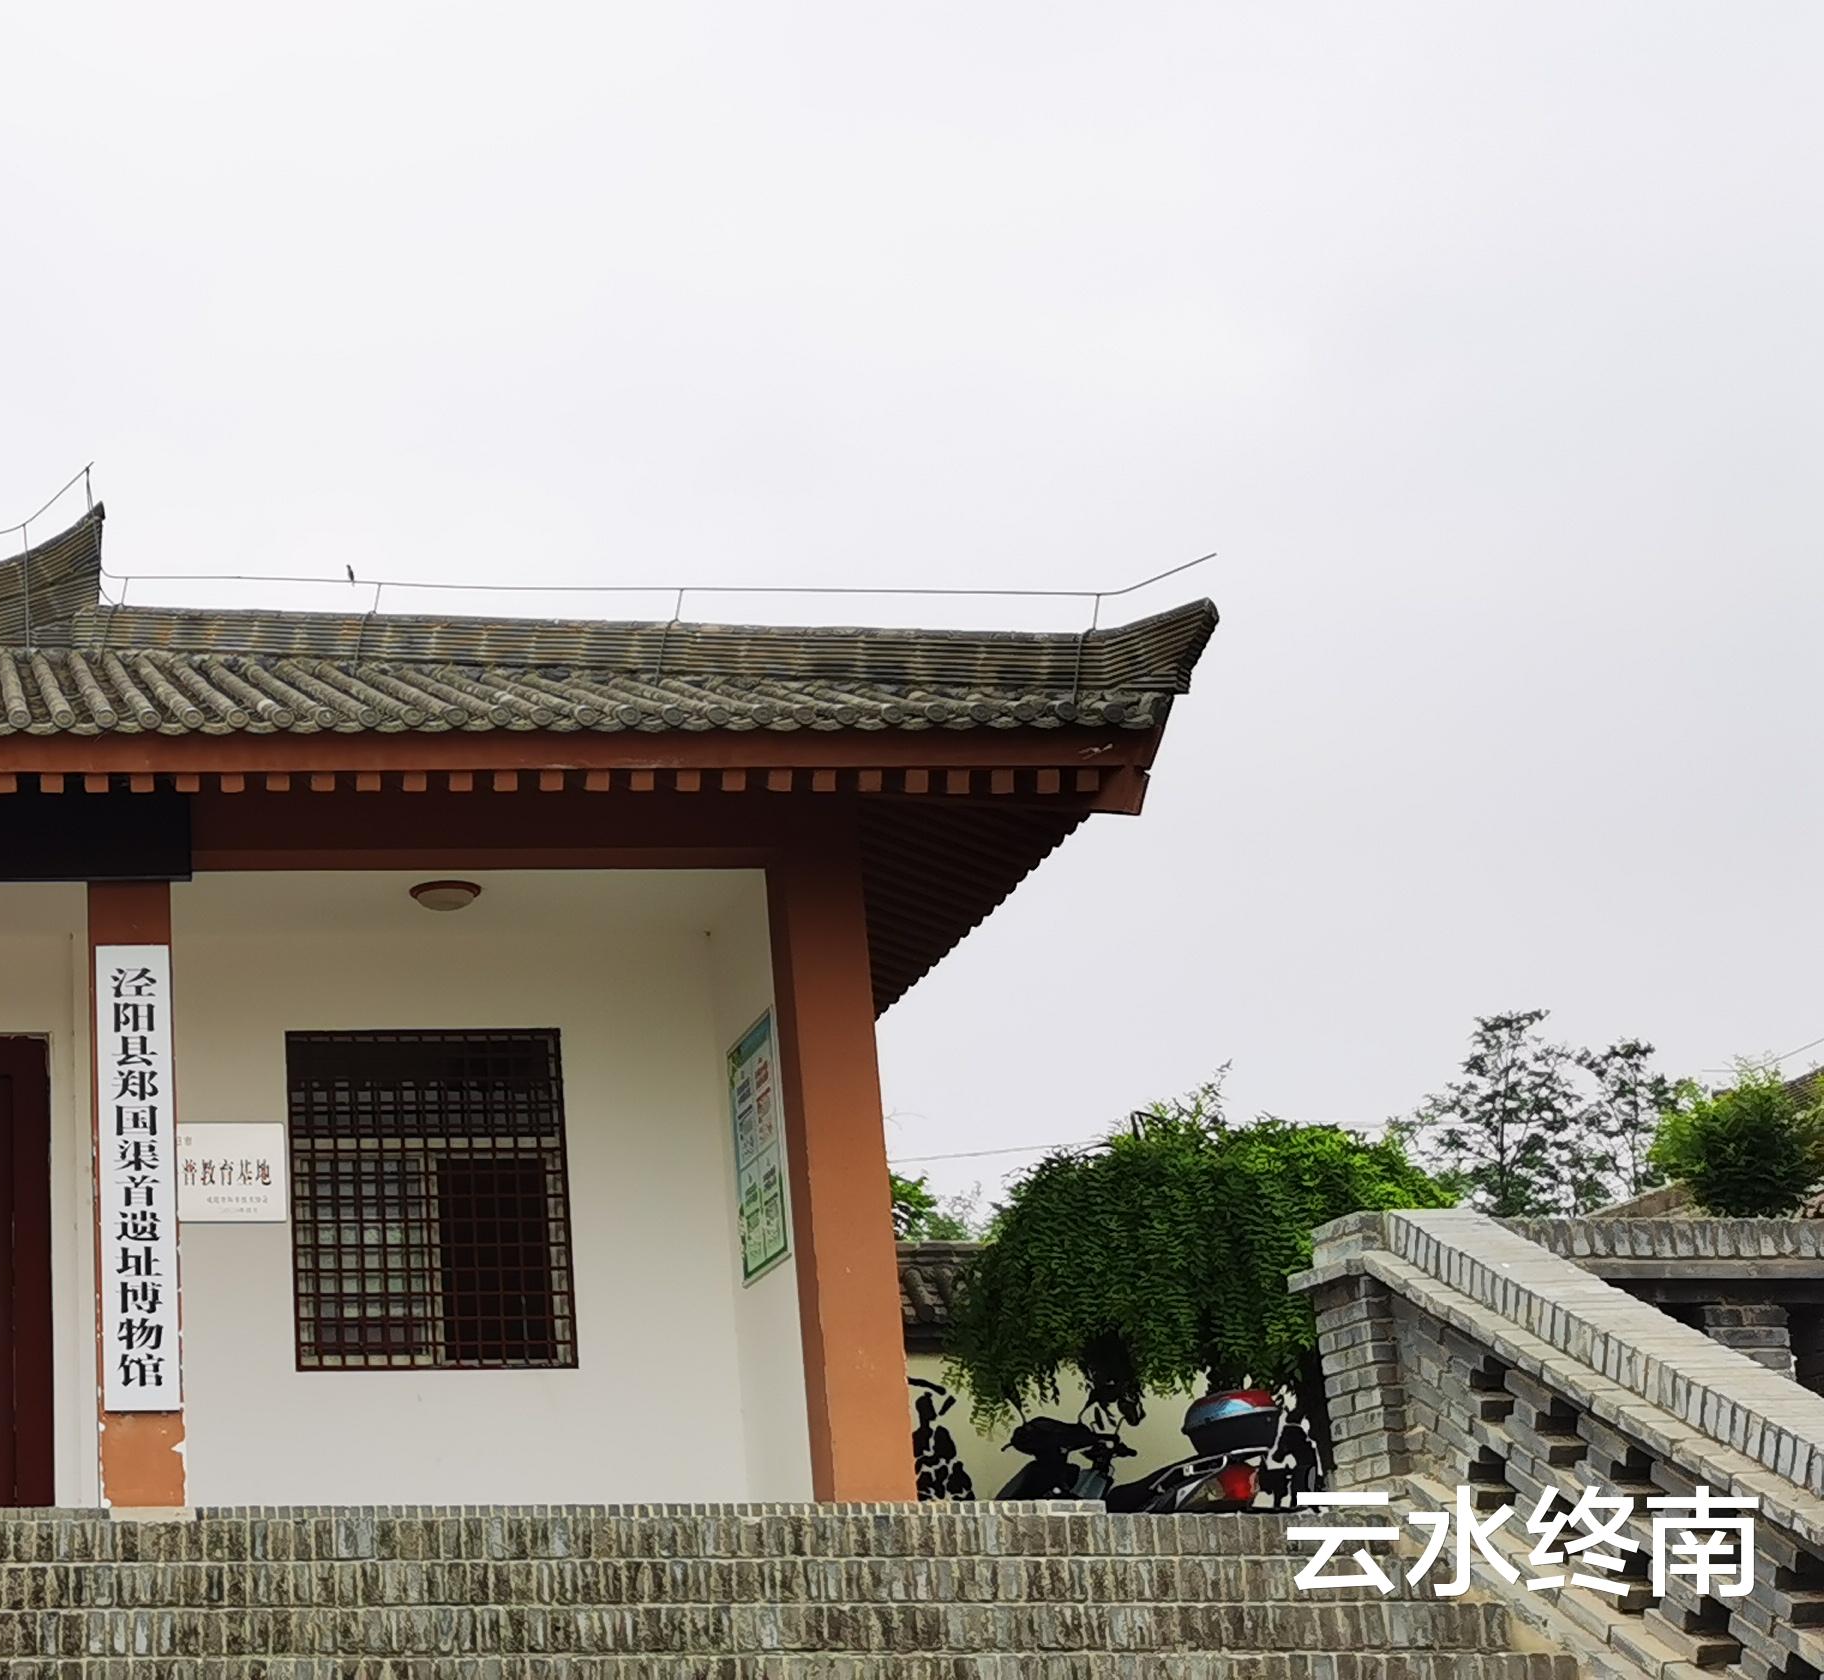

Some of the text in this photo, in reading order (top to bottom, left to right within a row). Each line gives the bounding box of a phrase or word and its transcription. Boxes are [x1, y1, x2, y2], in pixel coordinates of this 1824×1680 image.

[110, 967, 164, 1388] 泾阳县郑国渠首遗址博物馆
